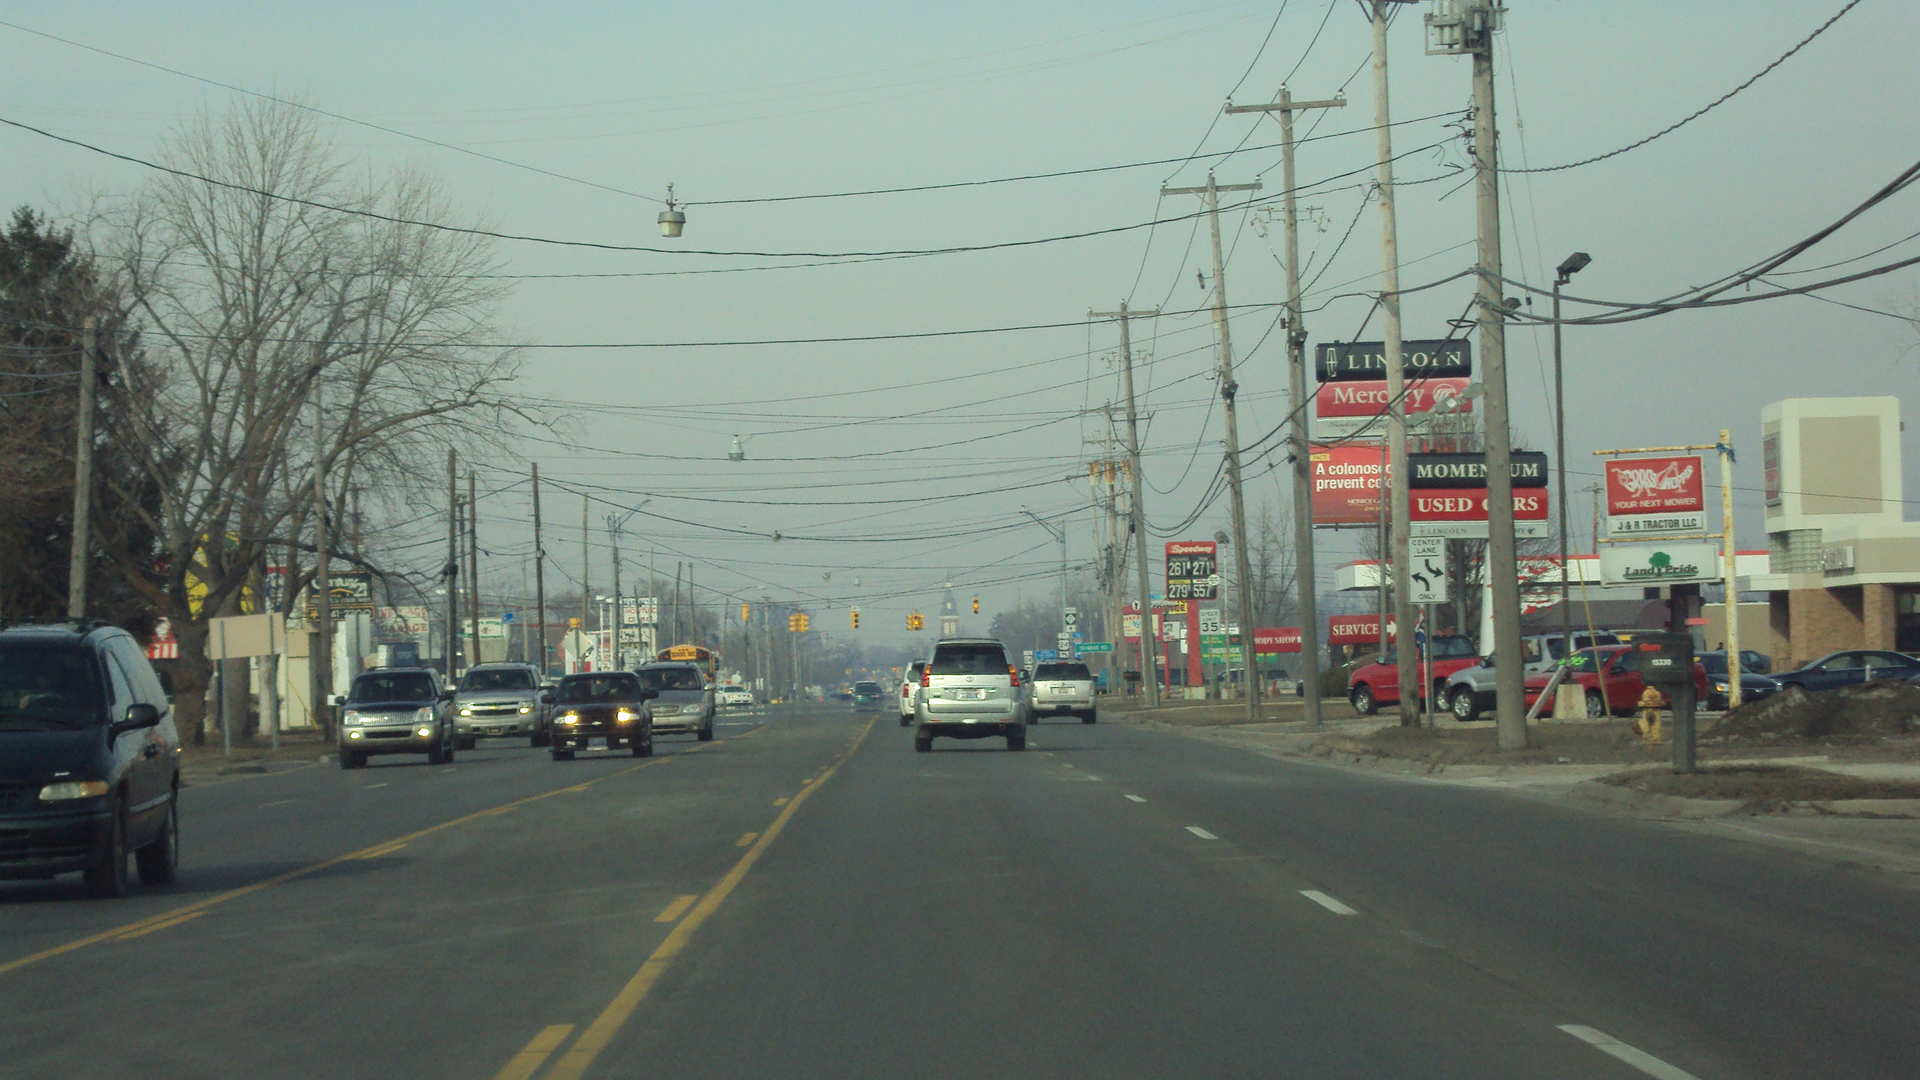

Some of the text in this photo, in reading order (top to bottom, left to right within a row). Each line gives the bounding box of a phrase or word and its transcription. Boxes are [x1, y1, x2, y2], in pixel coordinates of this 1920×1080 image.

[1316, 463, 1325, 475] A
[1316, 477, 1364, 492] prevent
[1417, 498, 1473, 512] USED
[1664, 498, 1697, 506] MOWER
[1617, 518, 1697, 530] J & R TRACTOR LLC
[1171, 545, 1213, 555] Speedway
[1625, 565, 1698, 576] Land Pride
[353, 582, 368, 597] 21
[1202, 622, 1219, 632] 35
[1332, 623, 1379, 636] SERVICE
[1274, 635, 1296, 644] SHOP
